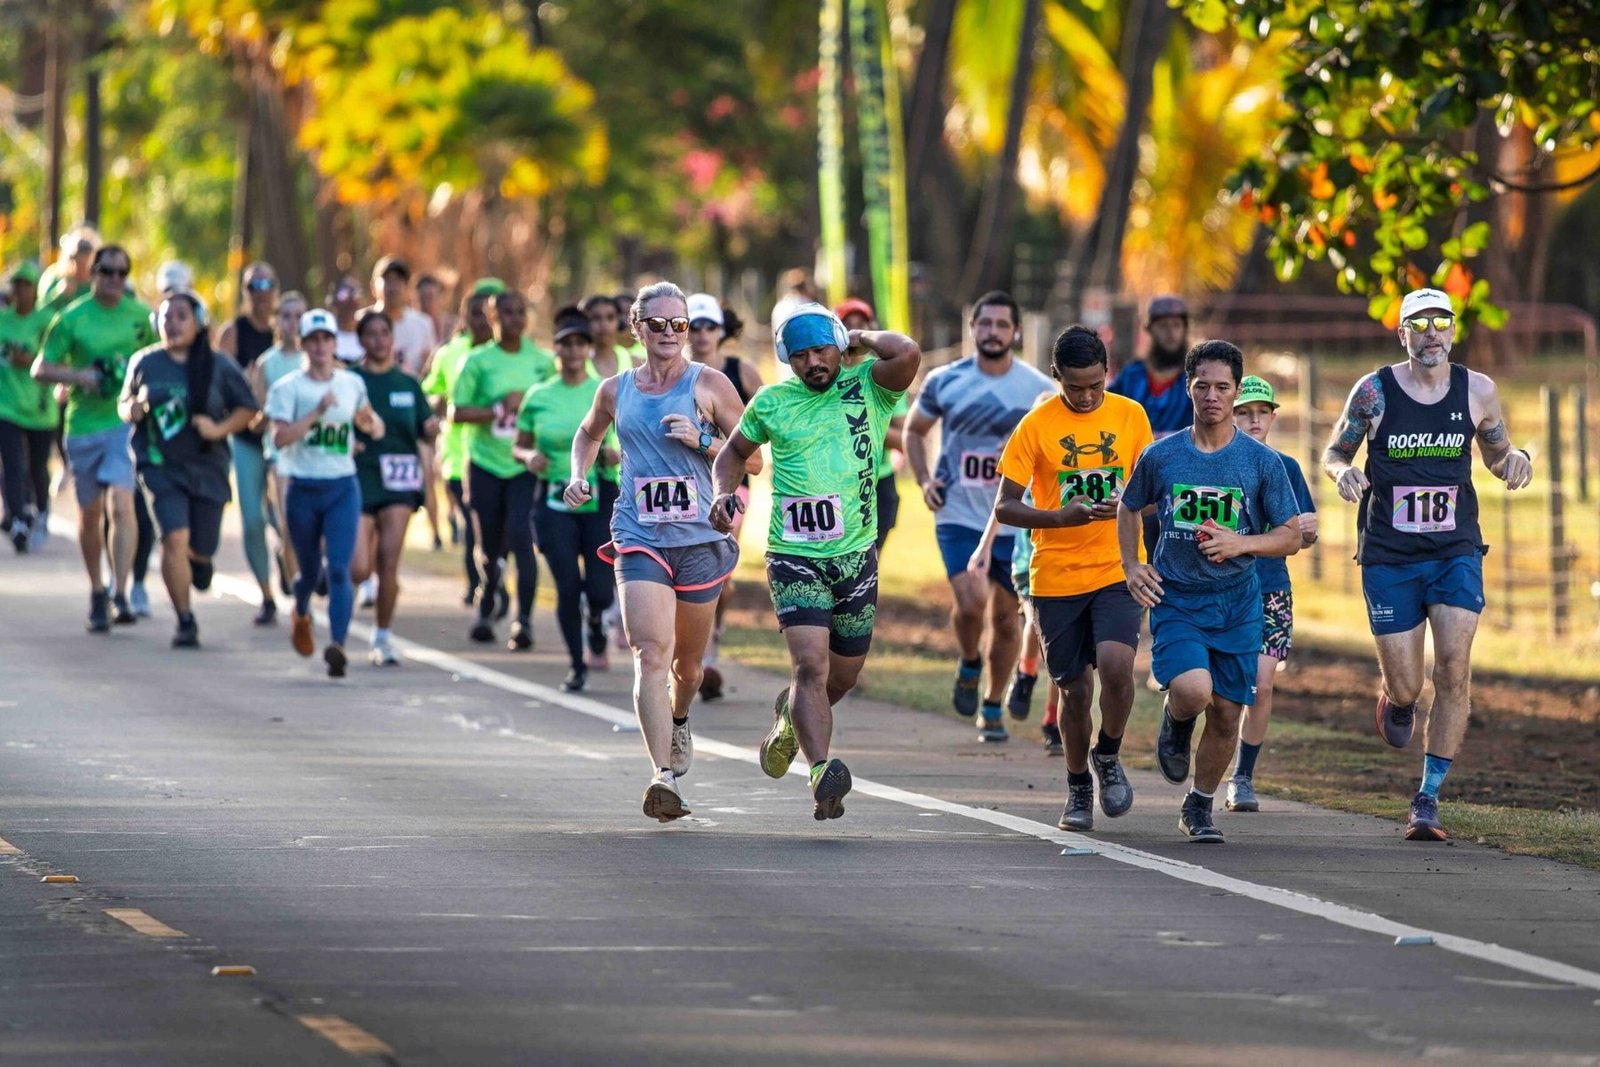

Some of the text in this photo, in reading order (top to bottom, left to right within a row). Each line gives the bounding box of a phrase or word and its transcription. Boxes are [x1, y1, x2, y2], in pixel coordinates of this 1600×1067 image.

[1388, 432, 1465, 449] ROCKLAND
[1389, 447, 1463, 458] ROAD RUNNERS
[641, 481, 691, 512] 144
[1066, 473, 1117, 504] 381
[787, 499, 836, 532] 140
[1180, 489, 1233, 522] 351
[1403, 491, 1450, 523] 118
[1164, 531, 1181, 540] THE
